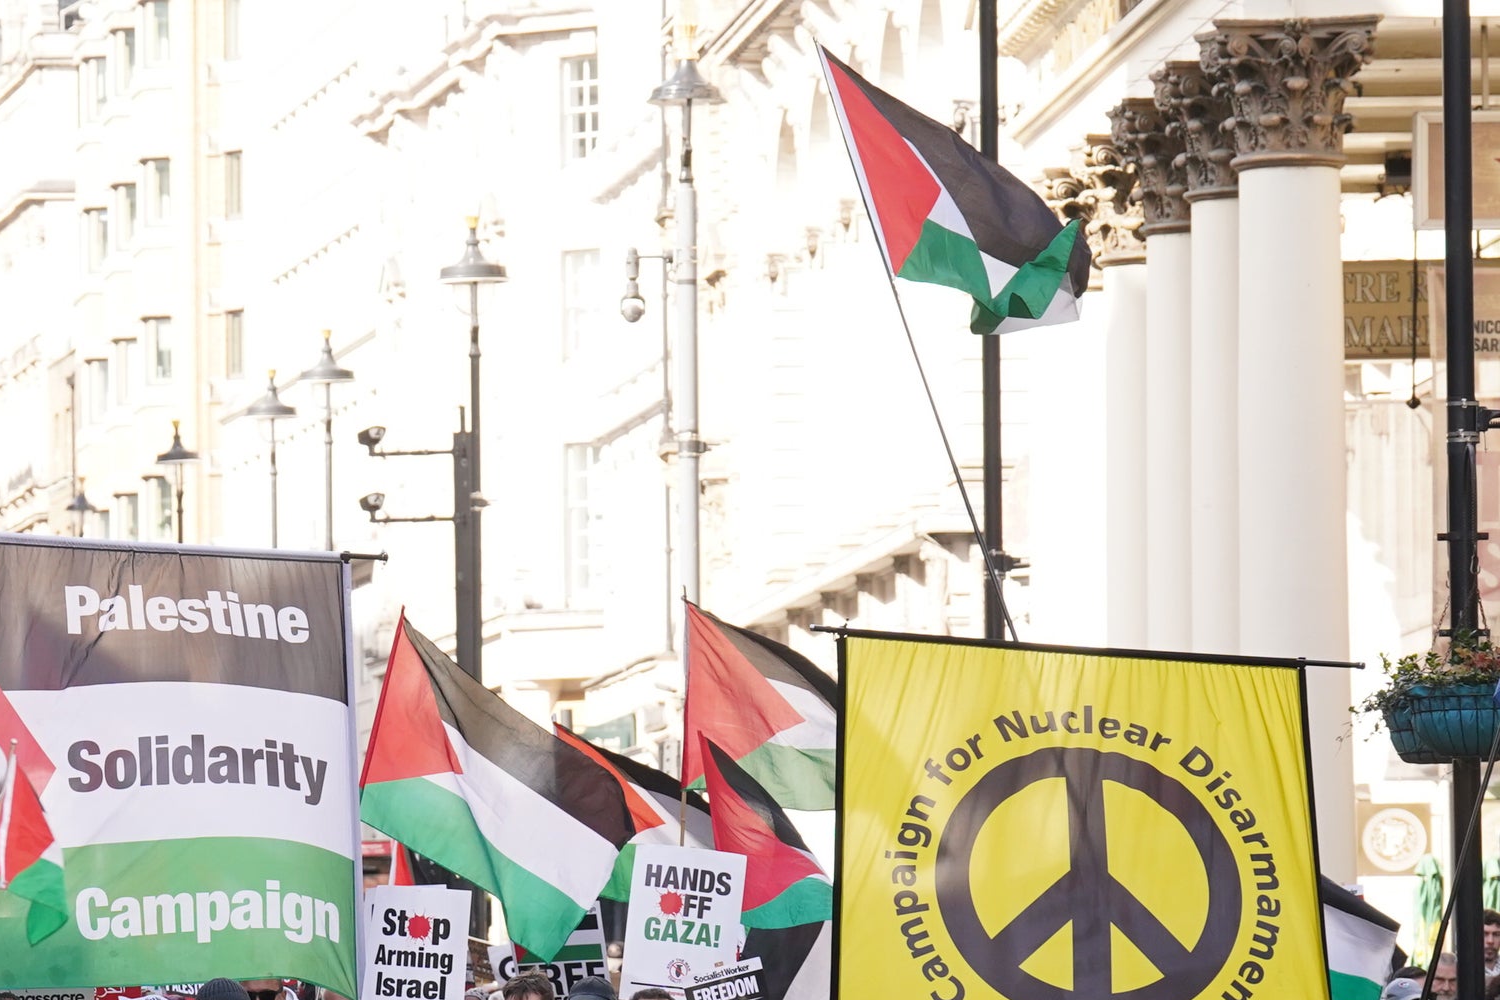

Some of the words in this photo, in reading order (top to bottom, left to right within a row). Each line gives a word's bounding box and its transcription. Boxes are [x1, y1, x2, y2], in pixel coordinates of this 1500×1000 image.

[63, 584, 310, 644] Palestine
[924, 733, 983, 788] for
[994, 704, 1173, 753] Nuclear
[67, 734, 328, 806] Solidarity
[644, 863, 732, 896] HANDS
[75, 879, 340, 944] Campaign
[644, 916, 722, 949] GAZA!
[375, 944, 454, 975] Arming
[693, 968, 724, 985] Socialist
[724, 963, 750, 979] Worker
[375, 971, 447, 1000] Israel
